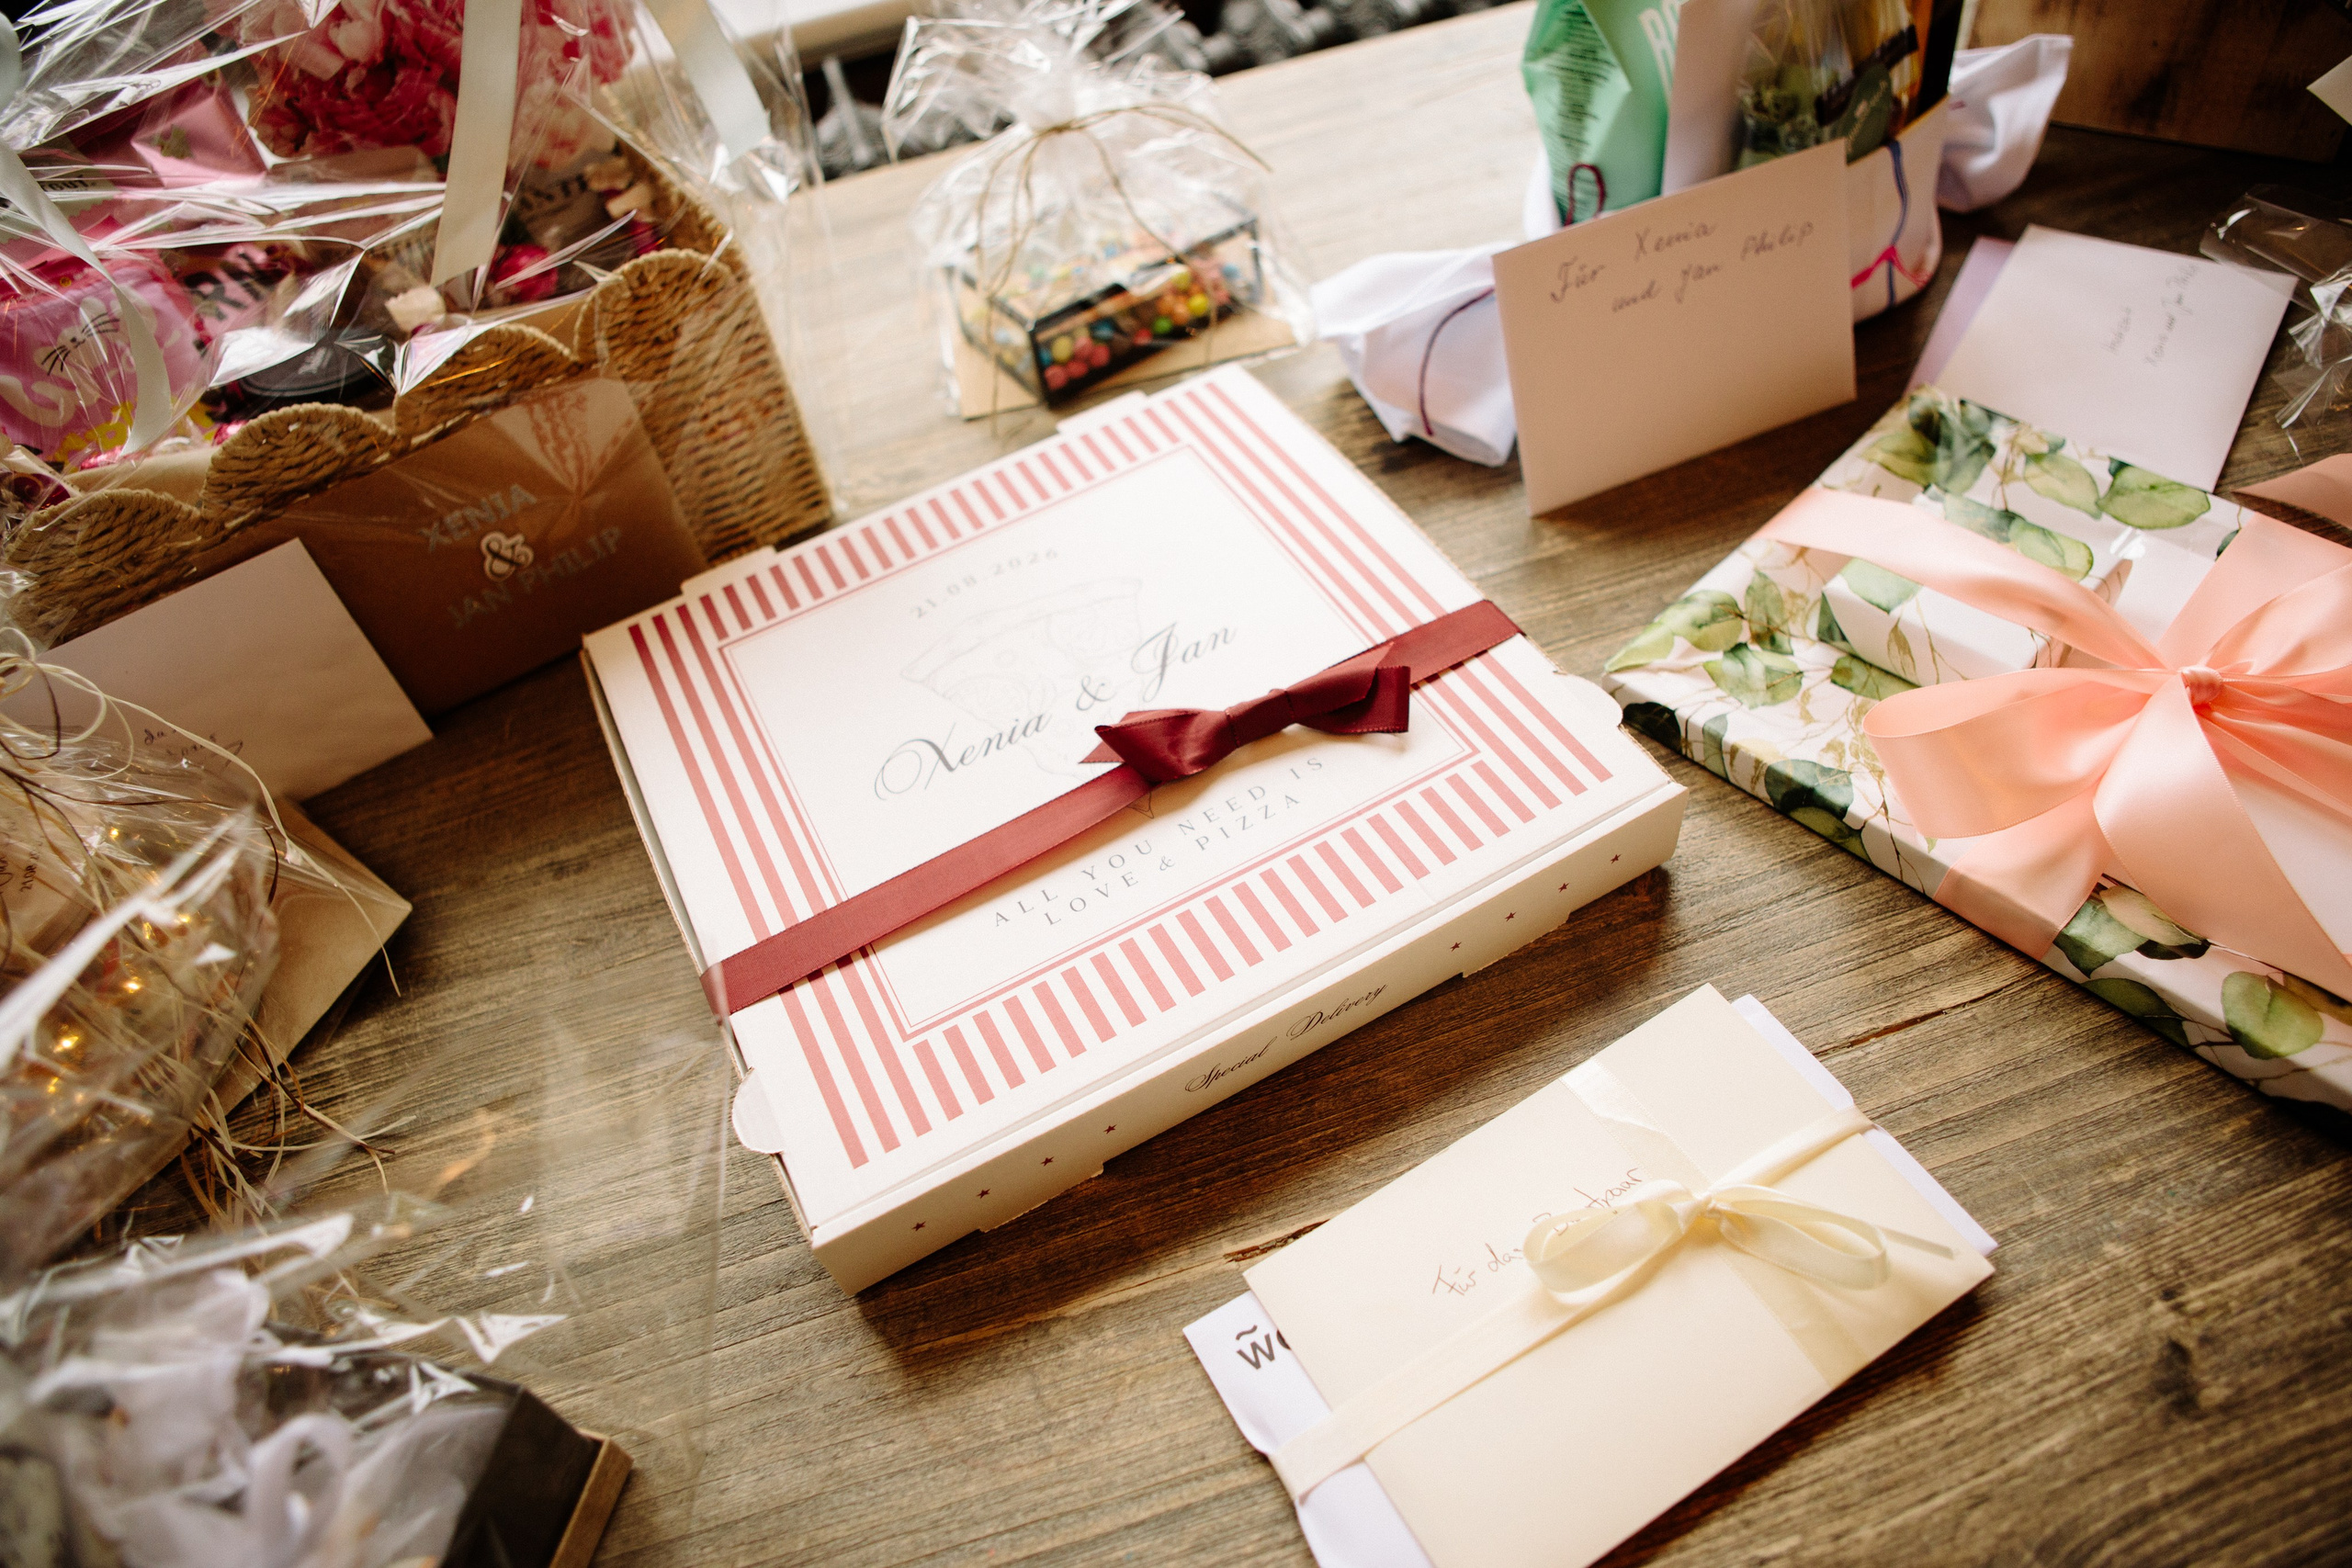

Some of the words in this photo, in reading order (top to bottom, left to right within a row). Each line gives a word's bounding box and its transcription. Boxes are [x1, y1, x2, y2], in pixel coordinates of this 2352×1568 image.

[1550, 255, 1606, 303] Für
[1634, 221, 1715, 263] Xenia
[417, 482, 537, 553] XENIA
[481, 531, 535, 582] &
[447, 582, 514, 629] JAN
[516, 525, 622, 594] PHILIP
[874, 711, 1053, 801] Xenia
[1075, 675, 1117, 711] &
[1131, 622, 1238, 704] Jan
[993, 886, 1058, 927] ALL
[1080, 840, 1153, 883] YOU
[1177, 785, 1266, 836] NEED
[1289, 757, 1323, 781] IS
[1044, 874, 1139, 926] LOVE
[1159, 855, 1176, 872] &
[1194, 795, 1301, 852] PIZZA
[1184, 1035, 1278, 1093] Special
[1286, 984, 1389, 1042] Delivery
[1431, 1264, 1476, 1296] Für
